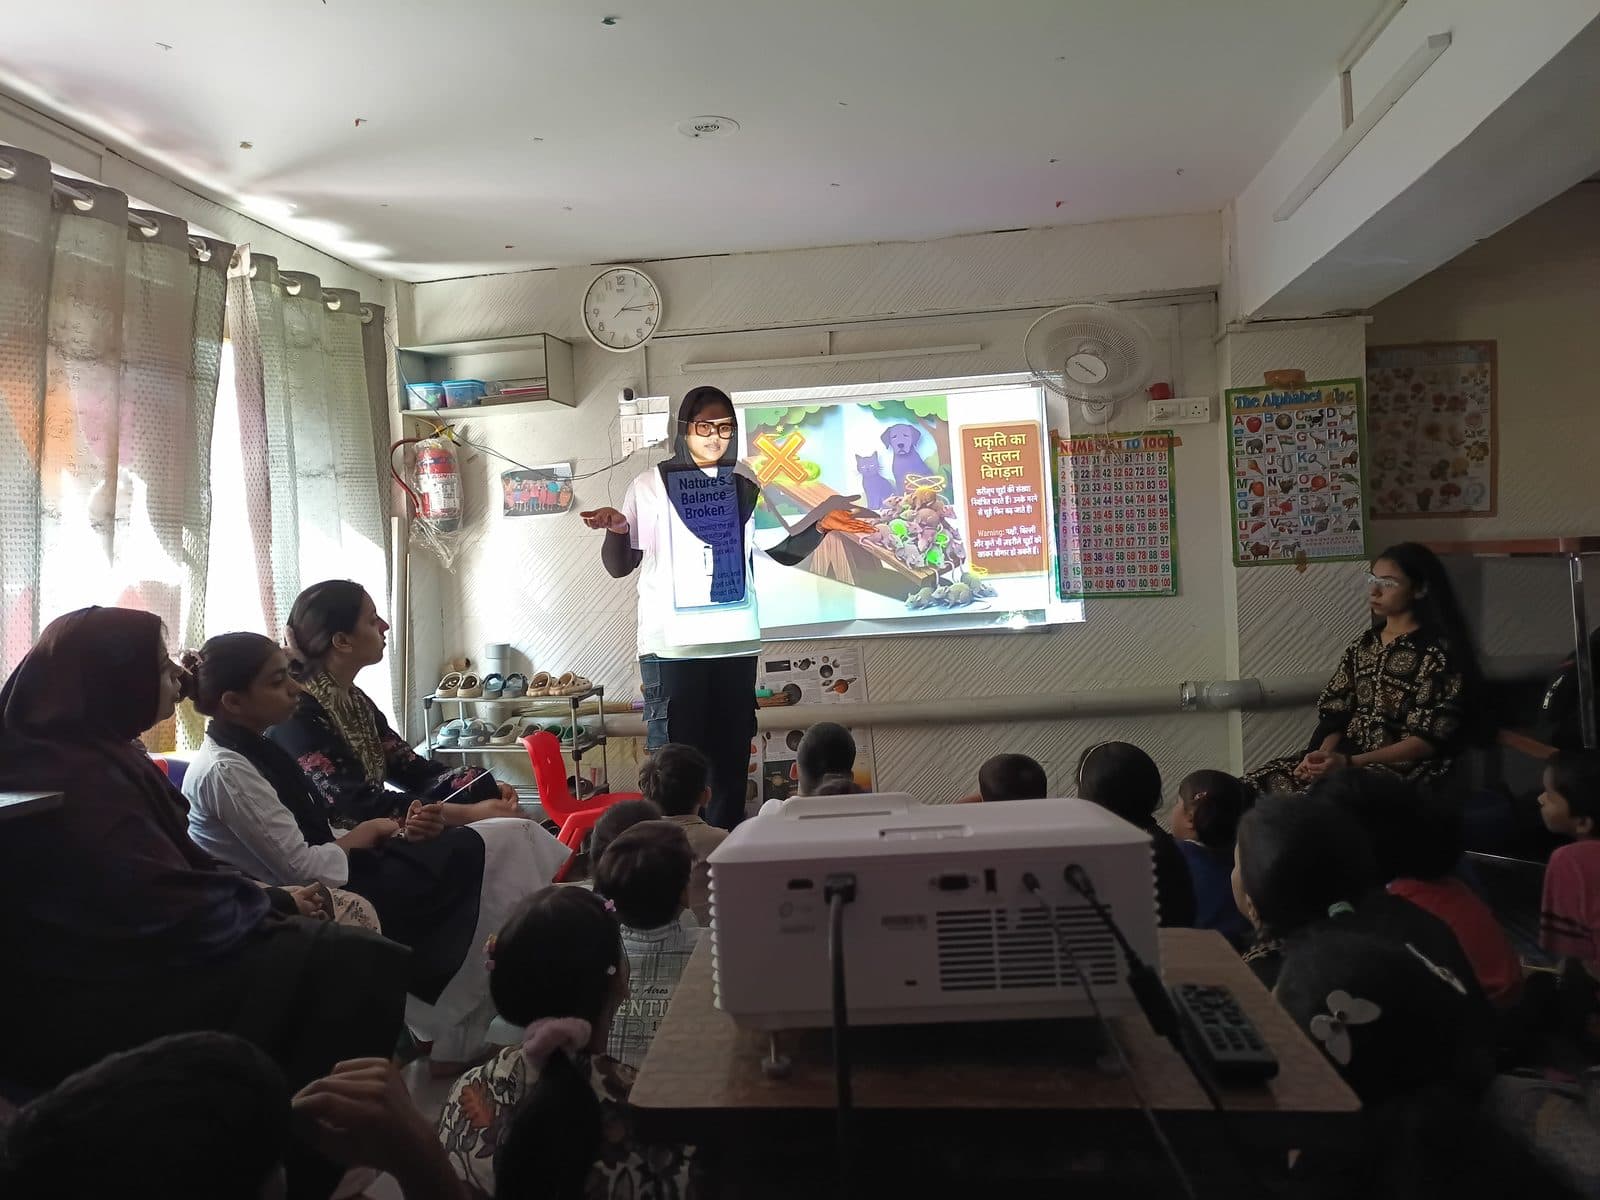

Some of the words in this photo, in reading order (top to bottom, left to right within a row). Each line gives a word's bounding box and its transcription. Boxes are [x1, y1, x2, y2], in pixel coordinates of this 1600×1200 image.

[616, 276, 625, 286] 12
[593, 309, 599, 317] 9
[598, 322, 605, 331] 8
[645, 316, 651, 325] 4
[610, 332, 615, 341] 7
[636, 328, 643, 337] 5
[1234, 395, 1259, 409] The
[1262, 390, 1321, 409] Alphabet
[1234, 416, 1244, 425] A
[1264, 414, 1274, 422] B
[1327, 408, 1335, 417] D
[973, 432, 1007, 451] प्रकृति
[1010, 433, 1026, 445] का
[1126, 438, 1140, 449] TO
[1143, 437, 1165, 449] 100
[1235, 437, 1243, 446] E
[1266, 435, 1272, 444] F
[1297, 432, 1306, 441] G
[1328, 431, 1337, 439] H
[1080, 456, 1090, 465] 21
[1091, 456, 1100, 465] 31
[1135, 453, 1144, 463] 71
[1158, 452, 1167, 462] 91
[1267, 456, 1273, 465] J
[1297, 453, 1306, 462] K
[980, 465, 1023, 480] बिगड़ना
[1081, 470, 1090, 479] 22
[1103, 469, 1112, 478] 42
[1114, 468, 1123, 477] 52
[1135, 467, 1144, 476] 72
[1158, 466, 1168, 475] 92
[1081, 483, 1090, 493] 23
[1092, 483, 1101, 492] 33
[1103, 483, 1112, 492] 43
[1114, 482, 1123, 491] 53
[1136, 481, 1145, 490] 73
[1158, 480, 1168, 489] 93
[1236, 479, 1247, 488] M
[1268, 477, 1276, 486] N
[1300, 475, 1308, 484] O
[1330, 473, 1338, 481] P
[681, 491, 726, 505] Balance
[1081, 497, 1090, 506] 24
[1092, 497, 1101, 506] 34
[1103, 496, 1112, 506] 44
[1114, 496, 1123, 505] 54
[1136, 495, 1145, 504] 74
[1159, 494, 1168, 503] 94
[1238, 500, 1248, 510] Q
[1300, 495, 1309, 505] S
[1331, 494, 1339, 503] T
[685, 505, 725, 520] Broken
[1082, 511, 1091, 520] 25
[1093, 511, 1102, 520] 35
[1104, 510, 1113, 520] 45
[1115, 510, 1124, 519] 55
[1136, 509, 1146, 518] 75
[1159, 508, 1169, 517] 95
[1239, 521, 1247, 530] U
[1271, 519, 1279, 528] V
[1301, 516, 1315, 526] W
[977, 529, 1004, 537] Warning:
[1082, 539, 1091, 548] 27
[1093, 539, 1102, 548] 37
[1104, 538, 1113, 547] 47
[1115, 538, 1124, 547] 57
[1137, 537, 1146, 546] 77
[1160, 536, 1170, 545] 97
[1240, 542, 1248, 551] Y
[1271, 540, 1280, 549] Z
[1094, 566, 1103, 575] 39
[1105, 566, 1114, 575] 49
[1138, 564, 1147, 574] 79
[1160, 563, 1170, 573] 99
[1083, 580, 1092, 590] 30
[1095, 580, 1103, 589] 40
[1106, 580, 1114, 589] 50
[1149, 578, 1159, 587] 90
[1161, 577, 1171, 586] 100
[644, 984, 669, 995] Aires
